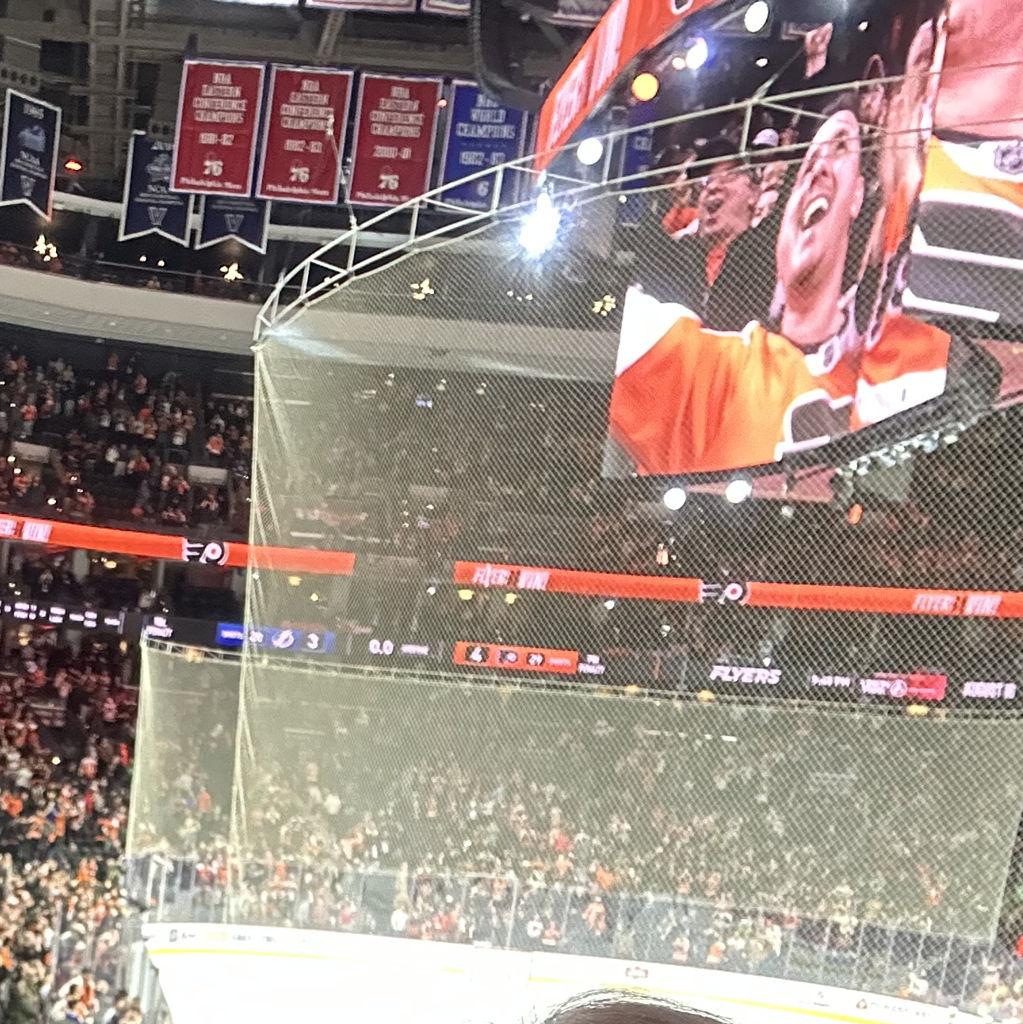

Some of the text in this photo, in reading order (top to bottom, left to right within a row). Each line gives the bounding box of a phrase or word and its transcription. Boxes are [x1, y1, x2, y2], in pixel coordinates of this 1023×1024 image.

[457, 122, 516, 139] CHAMPIONS
[203, 160, 223, 176] 76
[289, 167, 309, 182] 76
[378, 174, 400, 190] 76
[307, 633, 319, 649] 3
[709, 665, 782, 685] FLYERS
